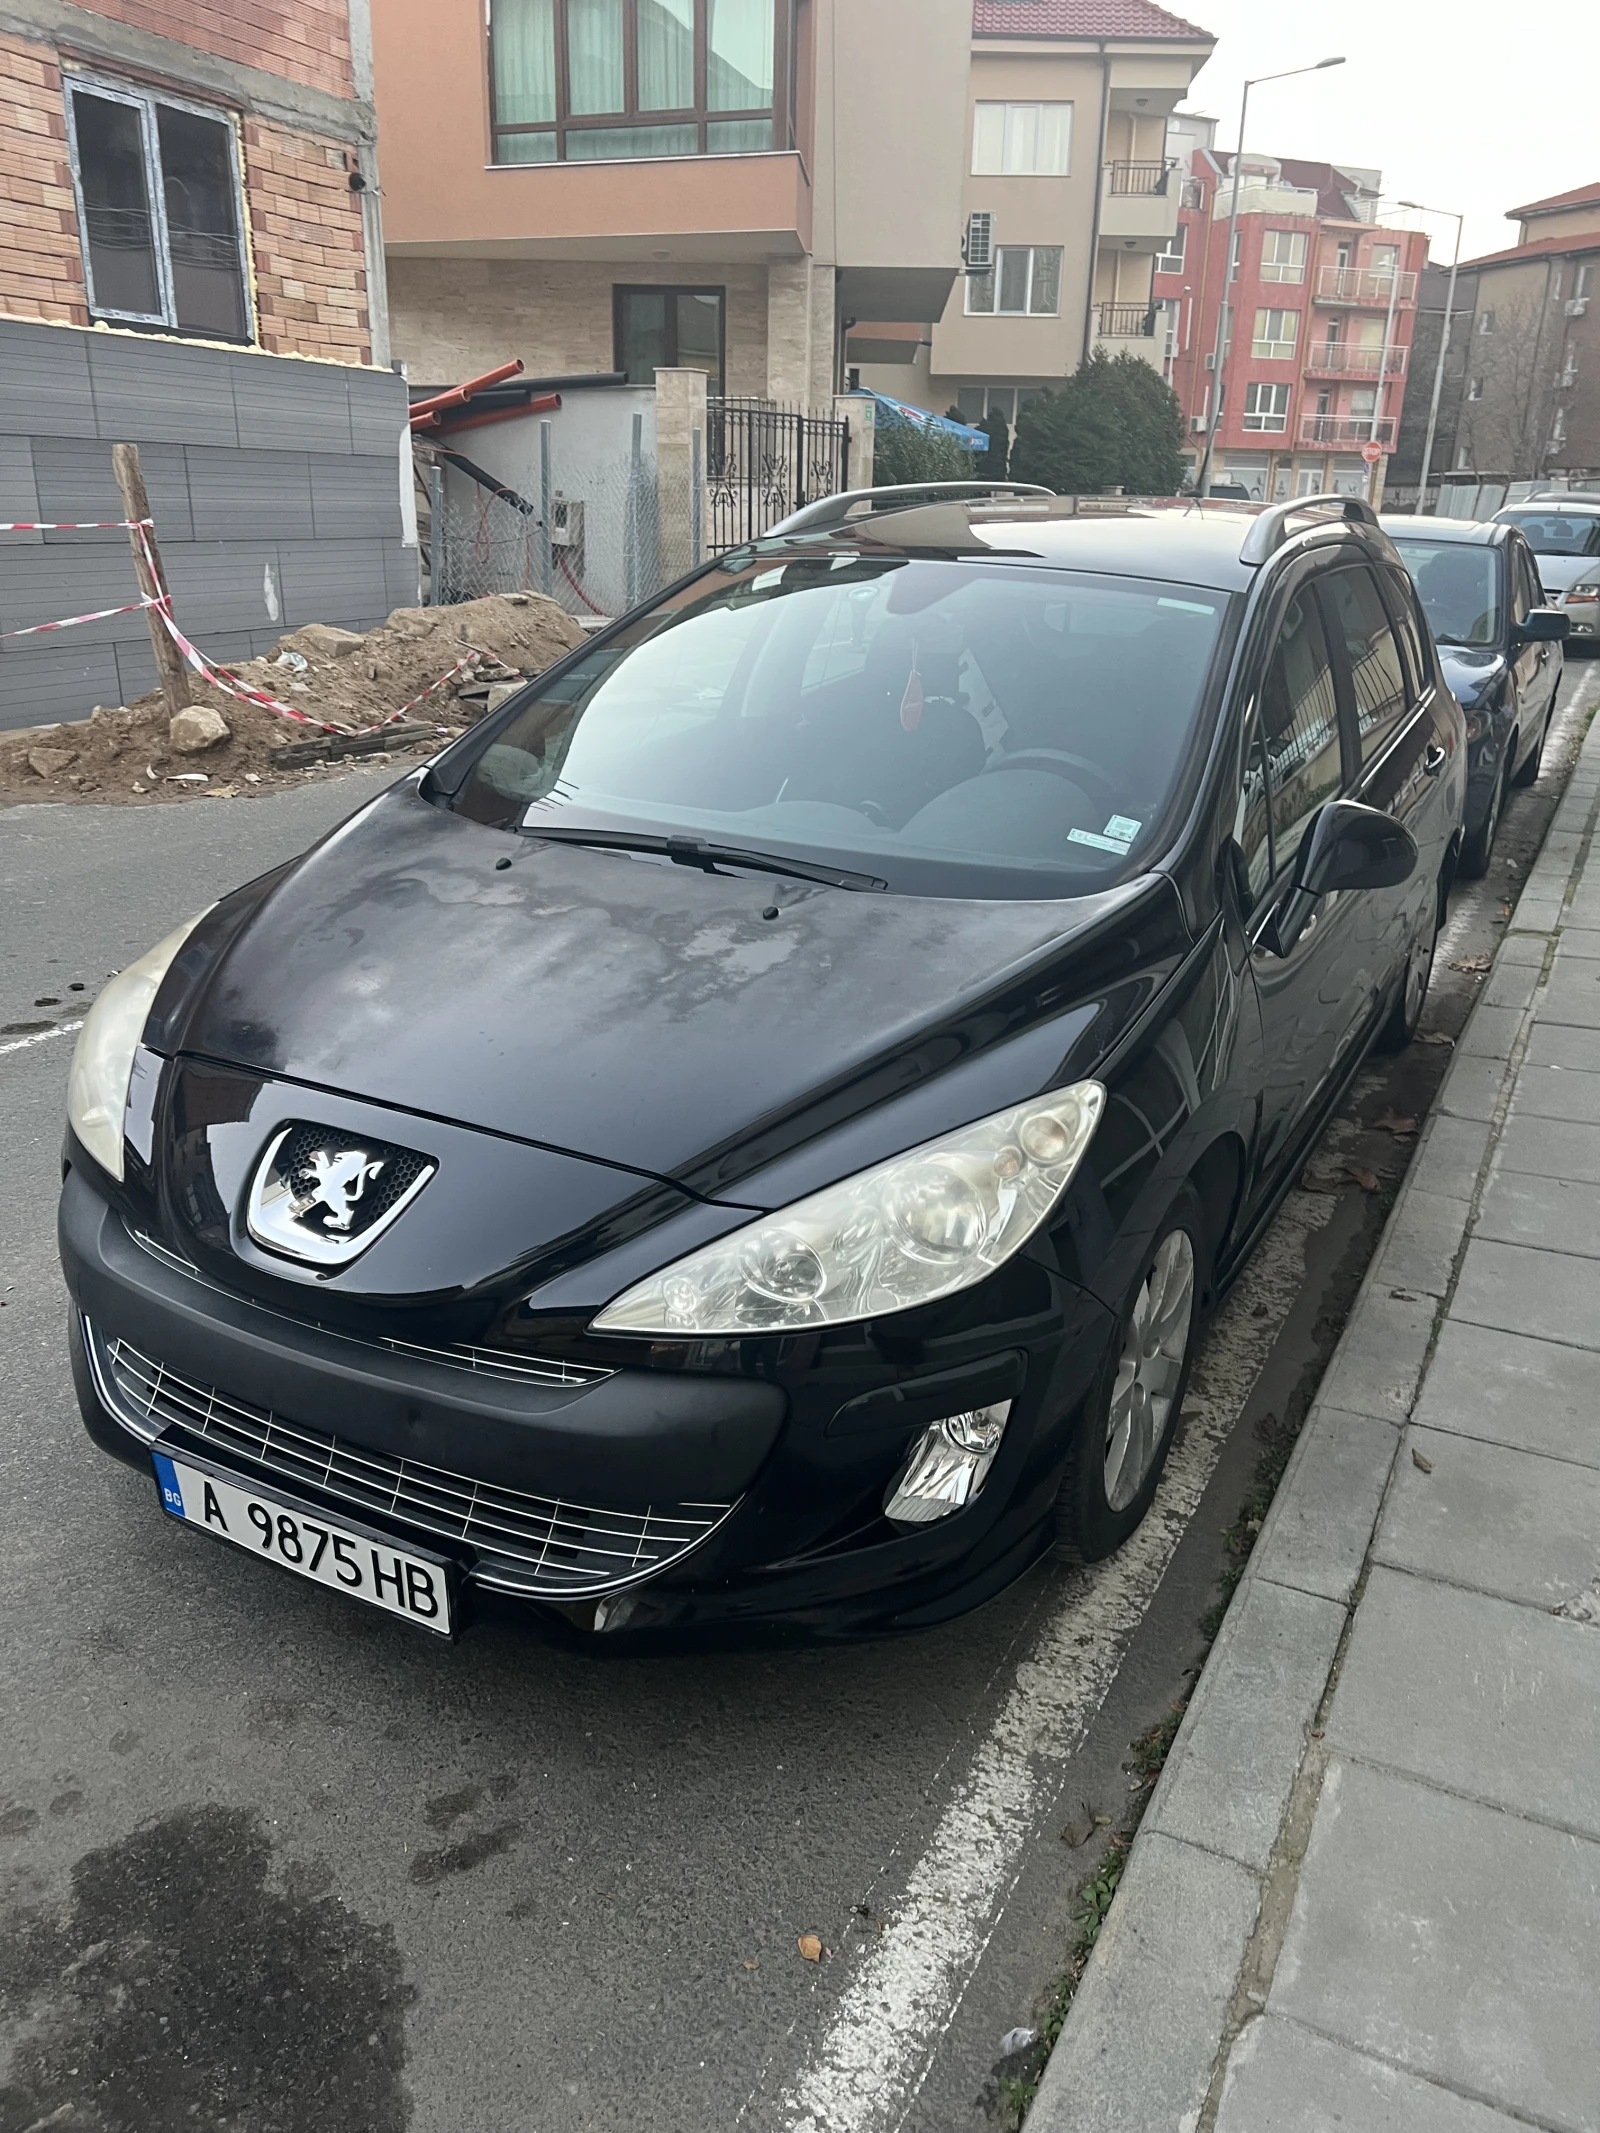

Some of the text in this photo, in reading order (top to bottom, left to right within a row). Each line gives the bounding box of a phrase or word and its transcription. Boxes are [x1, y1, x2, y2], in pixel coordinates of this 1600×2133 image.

[1362, 447, 1381, 456] STOP
[164, 1487, 181, 1506] BG
[204, 1480, 439, 1619] A 9875 HB
